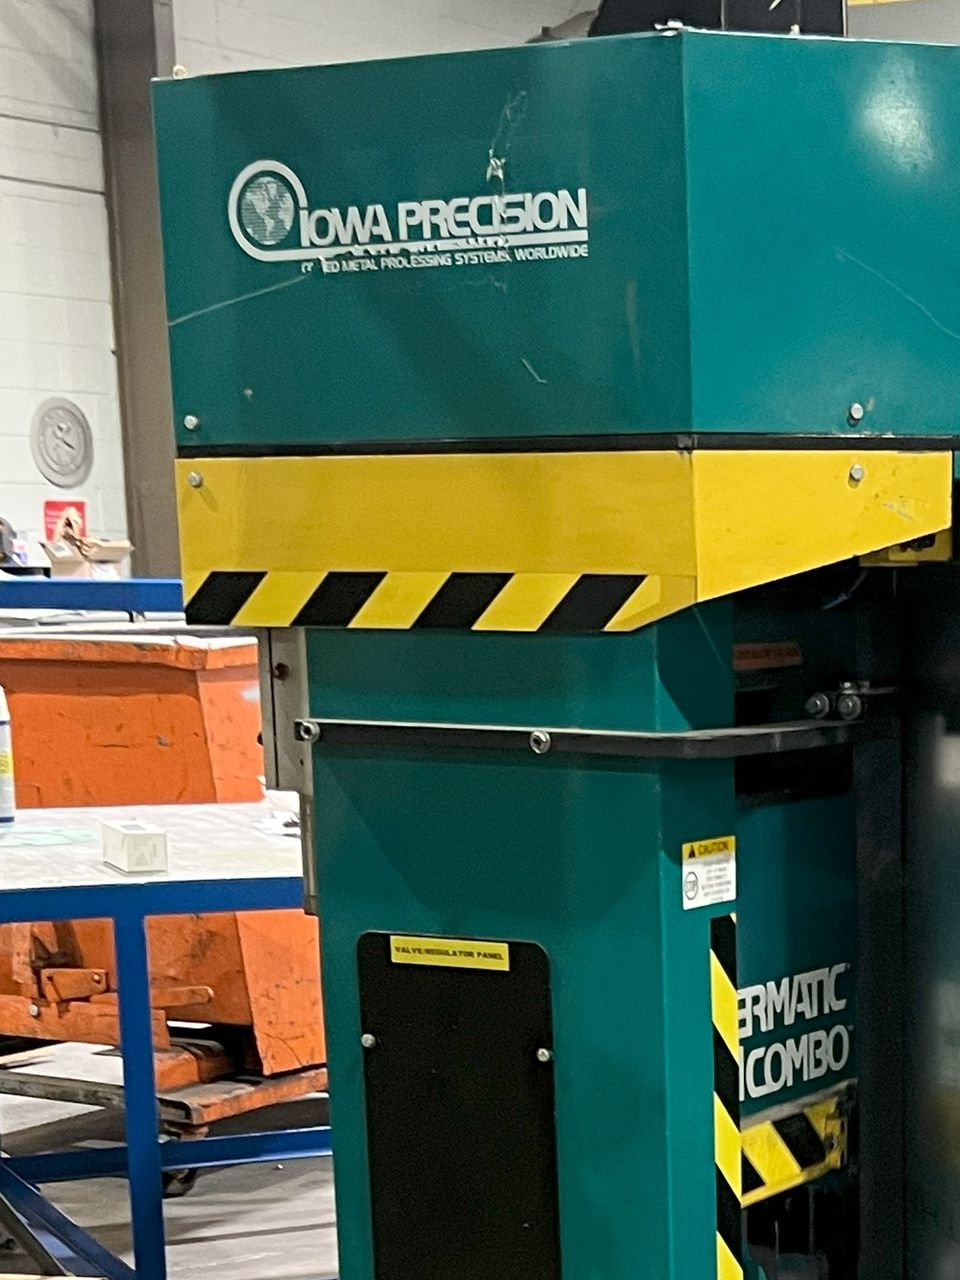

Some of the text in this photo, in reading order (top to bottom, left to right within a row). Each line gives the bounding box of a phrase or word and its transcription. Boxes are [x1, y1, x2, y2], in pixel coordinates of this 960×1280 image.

[300, 188, 588, 247] IOWA PRECISION
[514, 244, 588, 261] WORLDWIDE
[477, 952, 504, 961] PANEL
